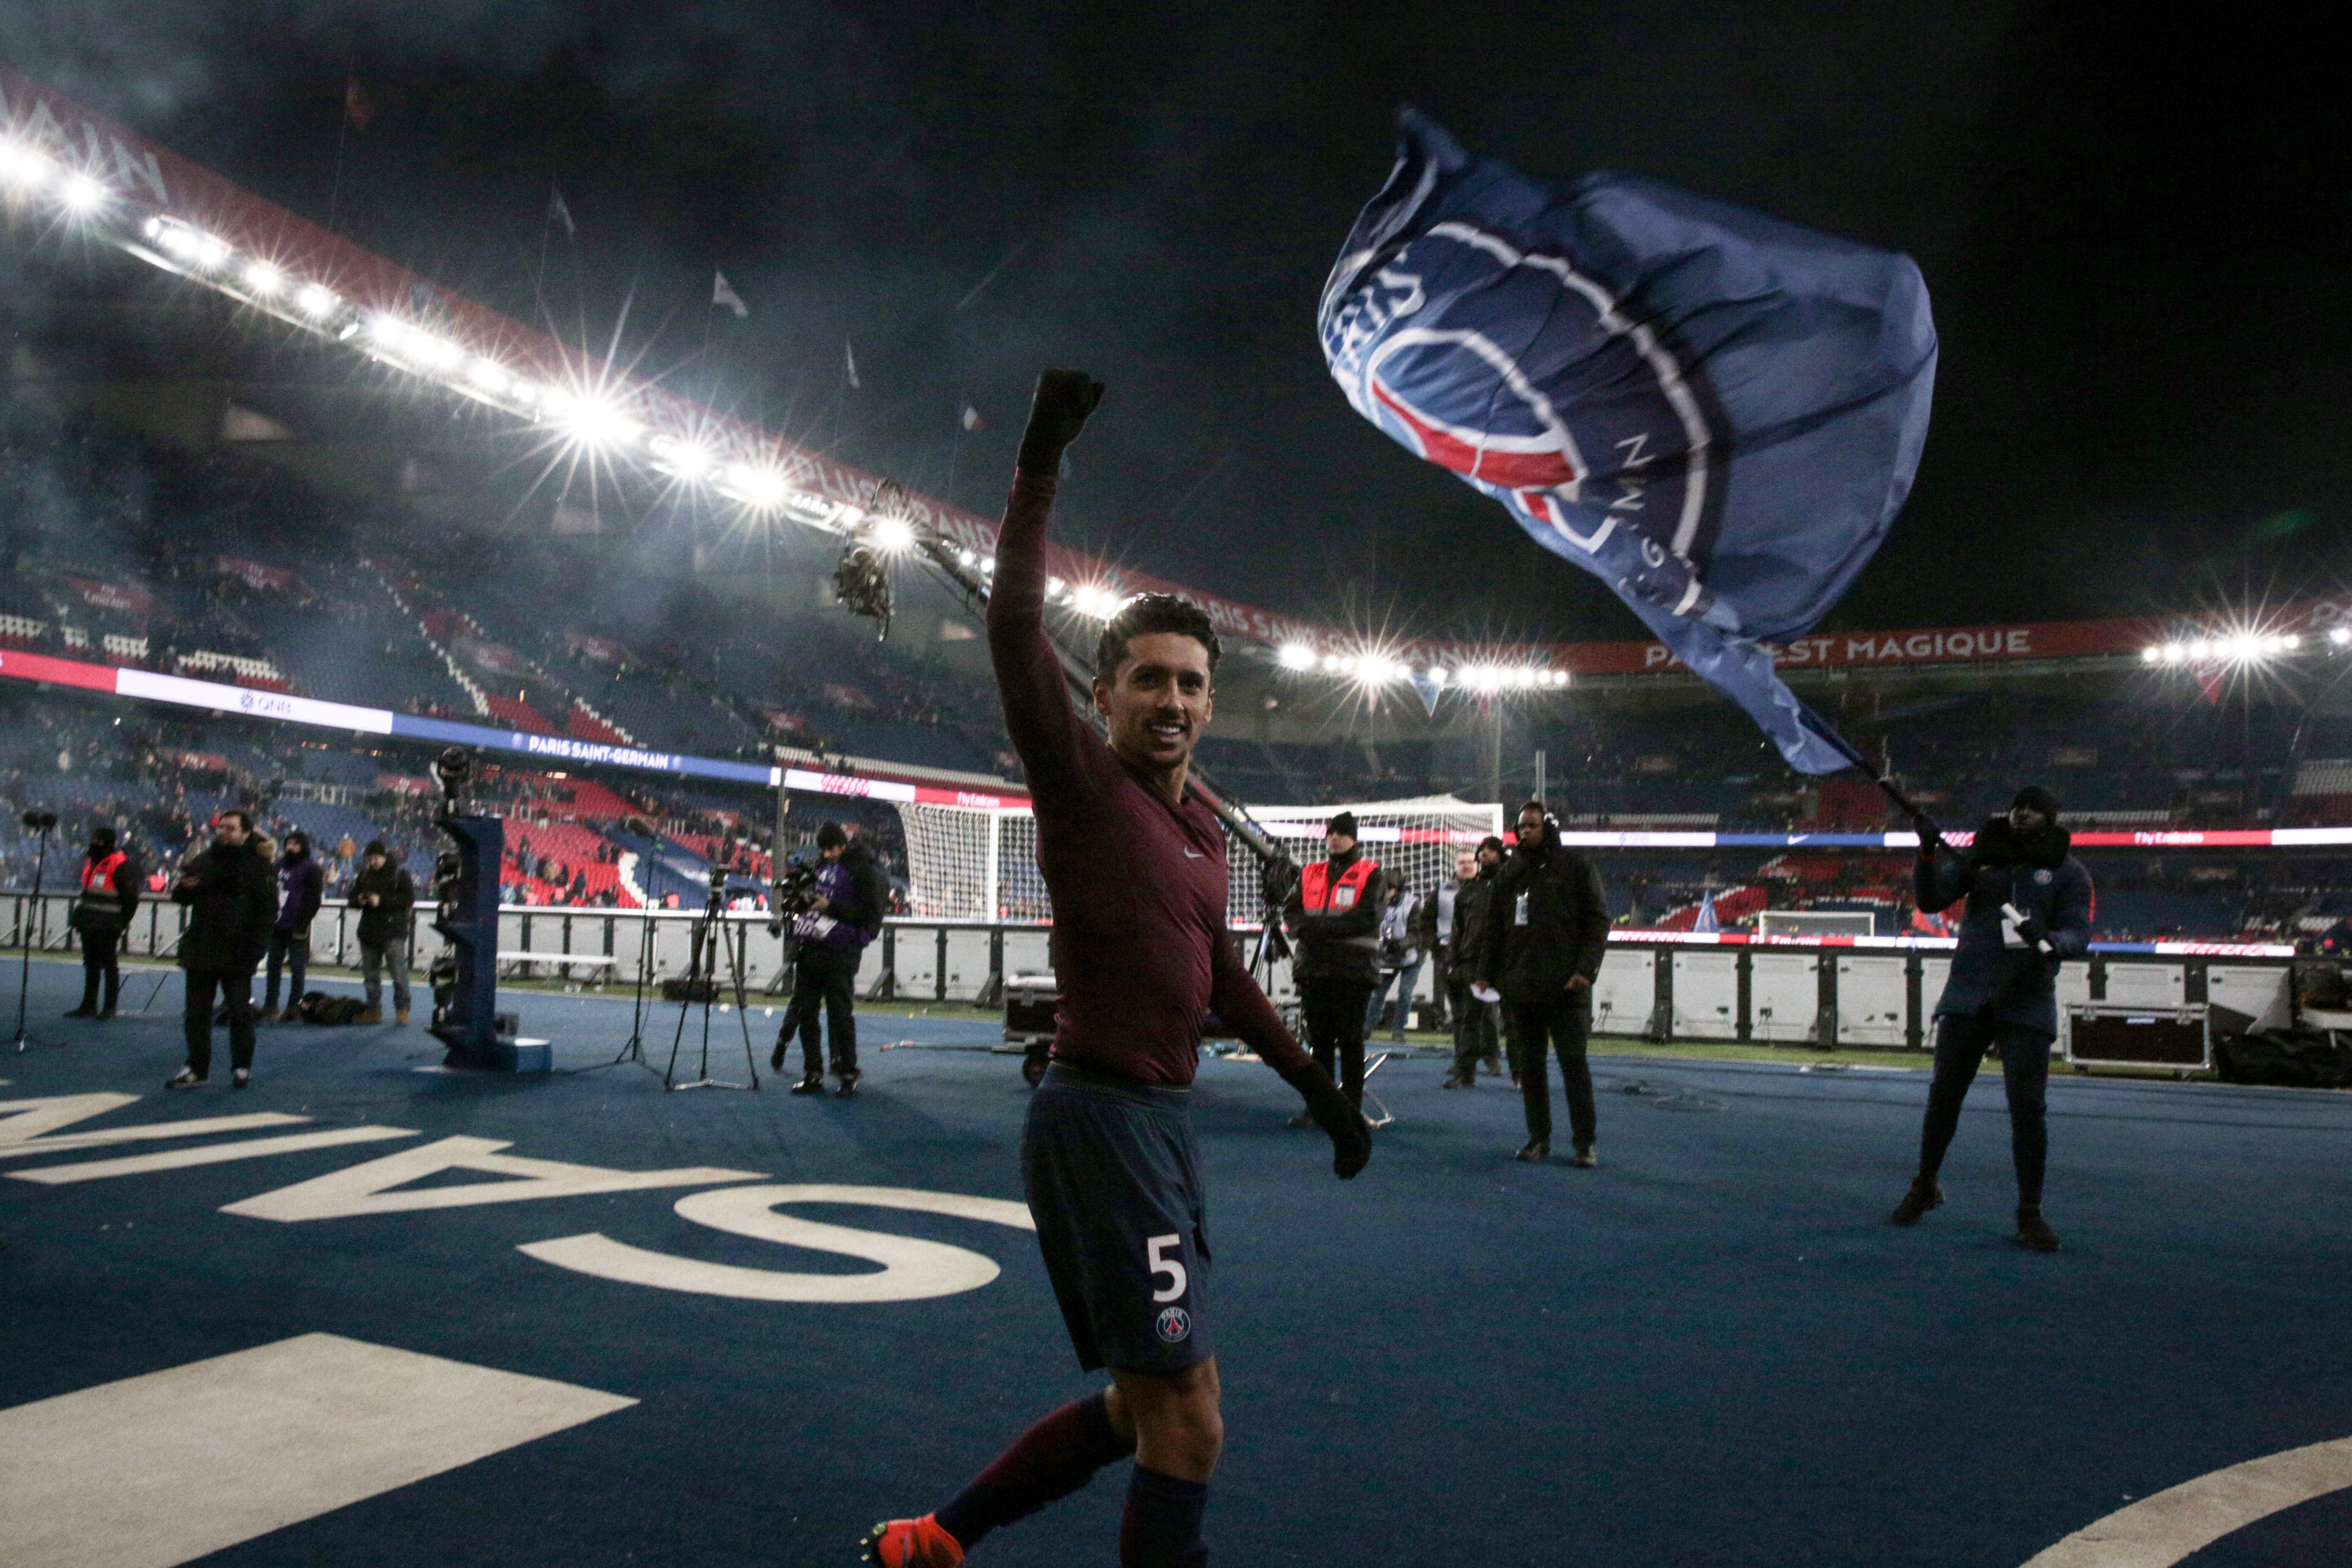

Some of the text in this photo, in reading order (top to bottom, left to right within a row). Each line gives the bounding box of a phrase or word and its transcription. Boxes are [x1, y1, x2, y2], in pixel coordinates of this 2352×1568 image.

[1847, 629, 2031, 660] MAGIQUE
[258, 697, 291, 714] QNB
[529, 735, 669, 769] PARIS SAINT-GERMAIN
[2135, 831, 2154, 845] Fly
[1148, 1233, 1187, 1302] 5
